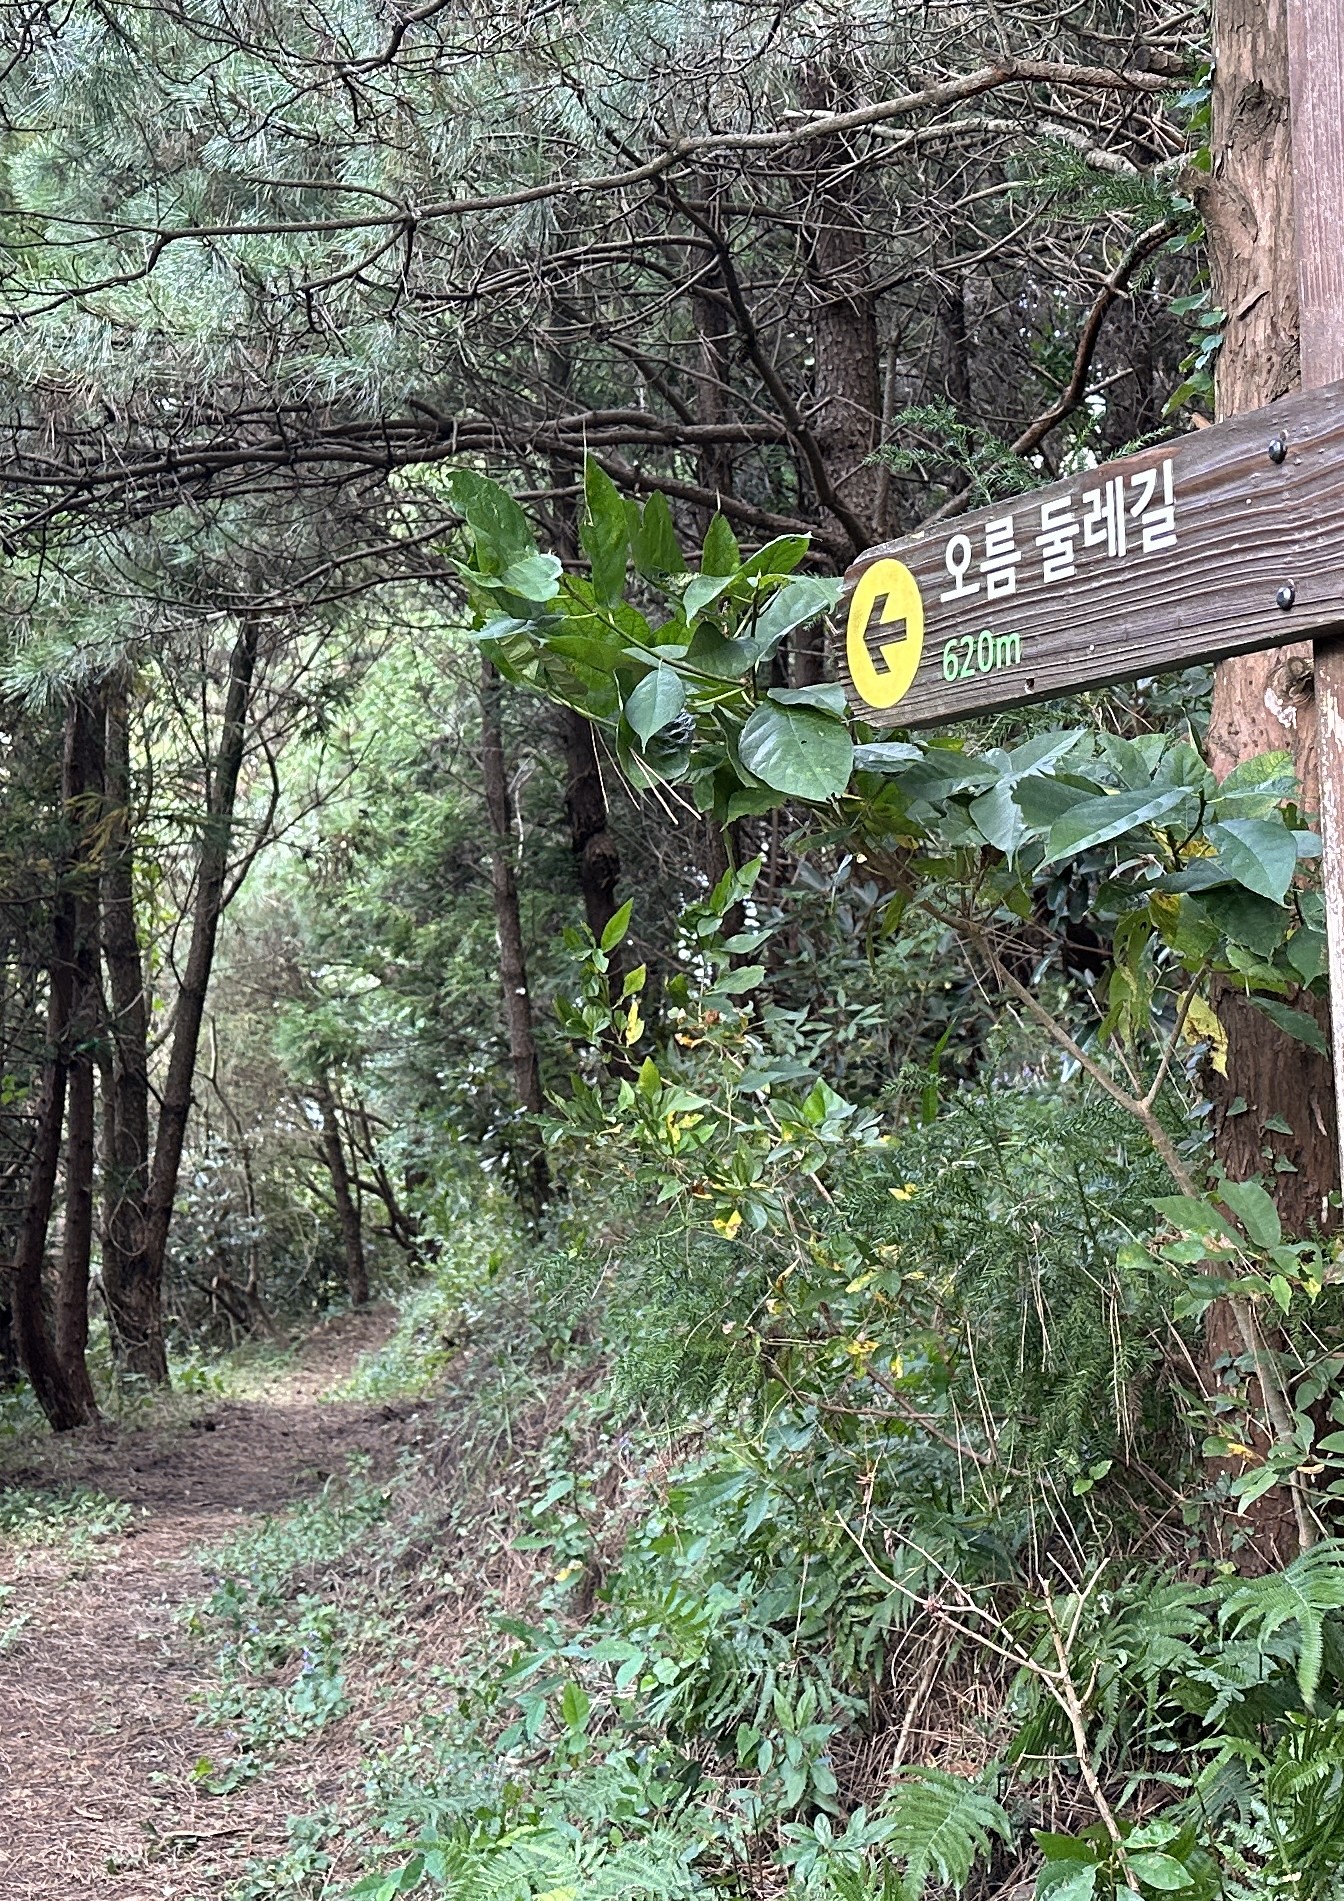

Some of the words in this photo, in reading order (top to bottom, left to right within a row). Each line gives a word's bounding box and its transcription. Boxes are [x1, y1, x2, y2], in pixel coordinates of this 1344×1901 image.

[939, 514, 1023, 604] 오름
[1035, 457, 1179, 585] 둘레길
[941, 628, 1023, 683] 620m
